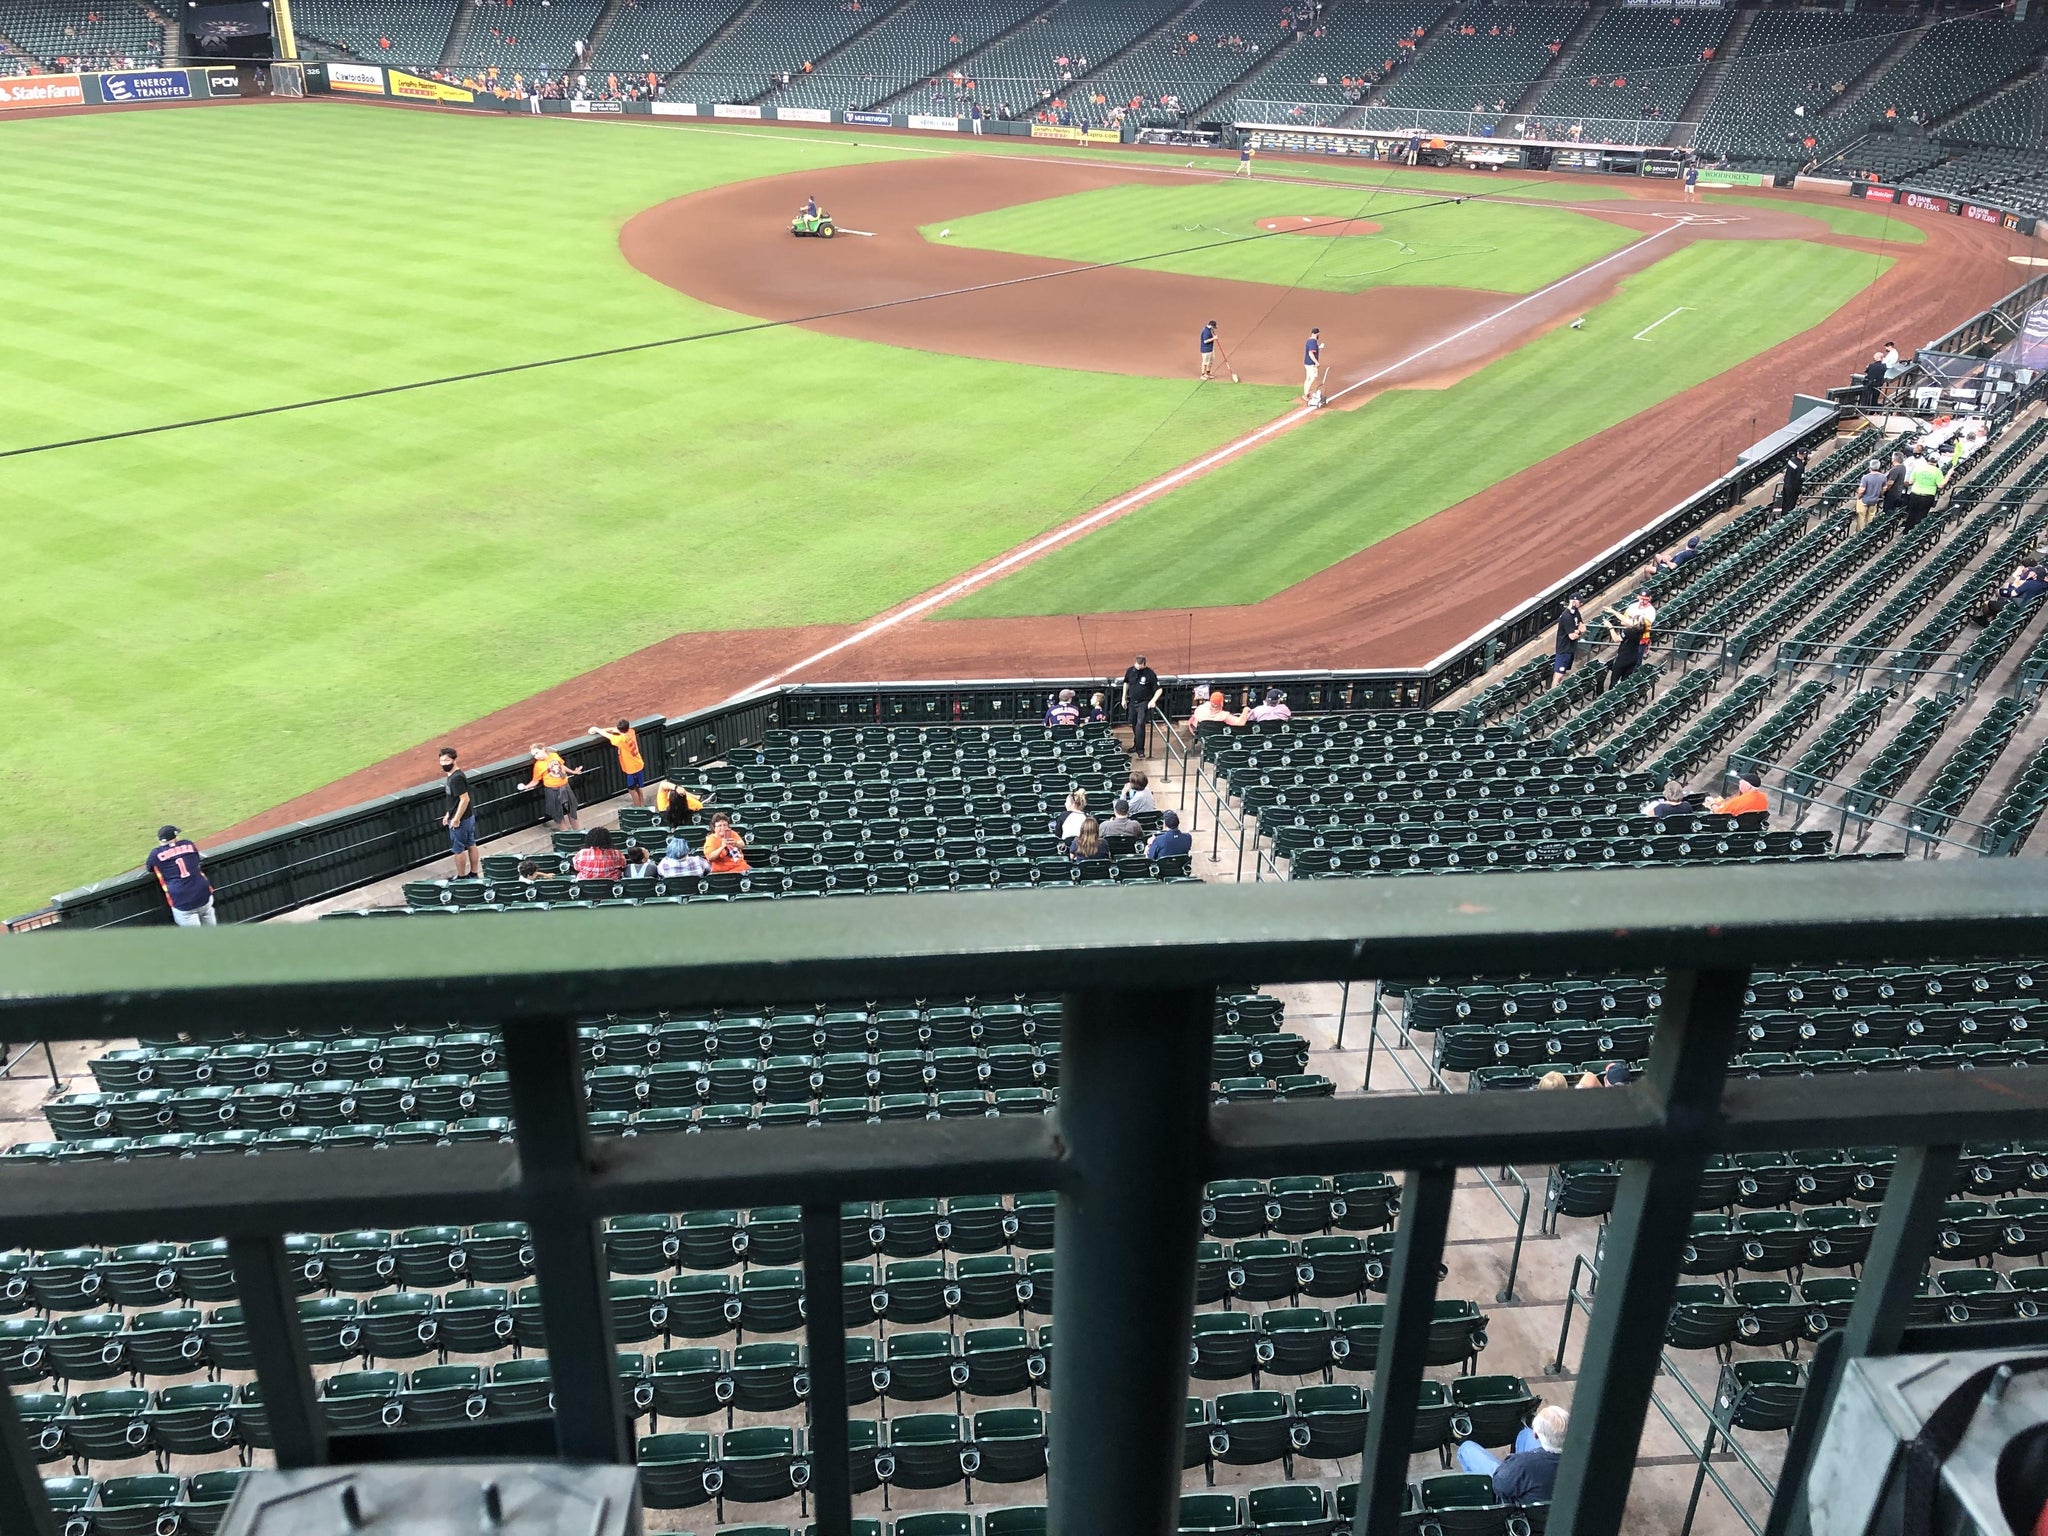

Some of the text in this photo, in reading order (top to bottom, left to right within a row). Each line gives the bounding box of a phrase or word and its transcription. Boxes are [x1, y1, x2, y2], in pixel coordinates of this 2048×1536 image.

[133, 77, 173, 88] ENERGY
[136, 86, 185, 98] TRANSFER
[1705, 171, 1750, 181] WOODFOREST
[1916, 195, 1932, 204] BANK
[1915, 200, 1923, 208] OF
[1923, 202, 1940, 212] TEXAS
[1976, 207, 1990, 215] BANK
[1981, 213, 1996, 223] TEXAS
[175, 857, 191, 879] 1
